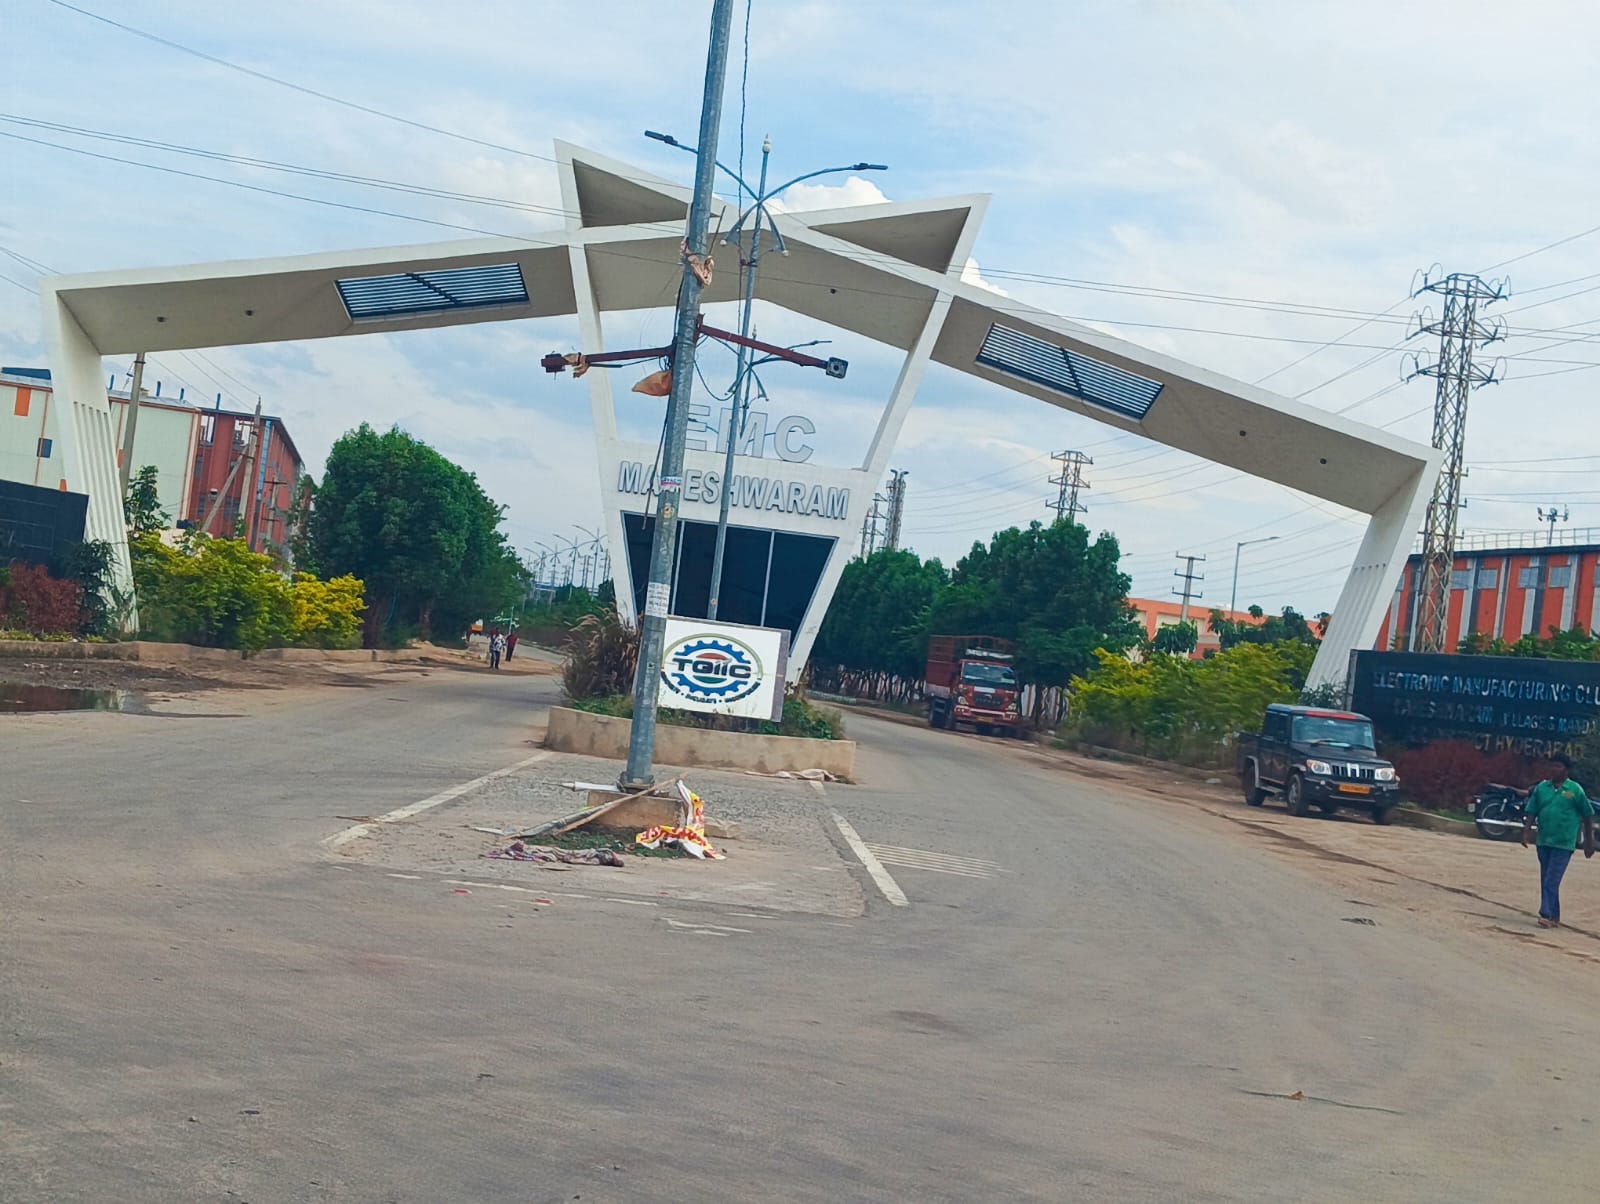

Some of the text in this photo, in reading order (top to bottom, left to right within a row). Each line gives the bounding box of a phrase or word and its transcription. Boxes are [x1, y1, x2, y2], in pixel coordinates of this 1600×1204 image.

[684, 403, 817, 463] EMC
[617, 460, 849, 519] MAESHWARAM
[1452, 675, 1571, 702] MANUFACTURING
